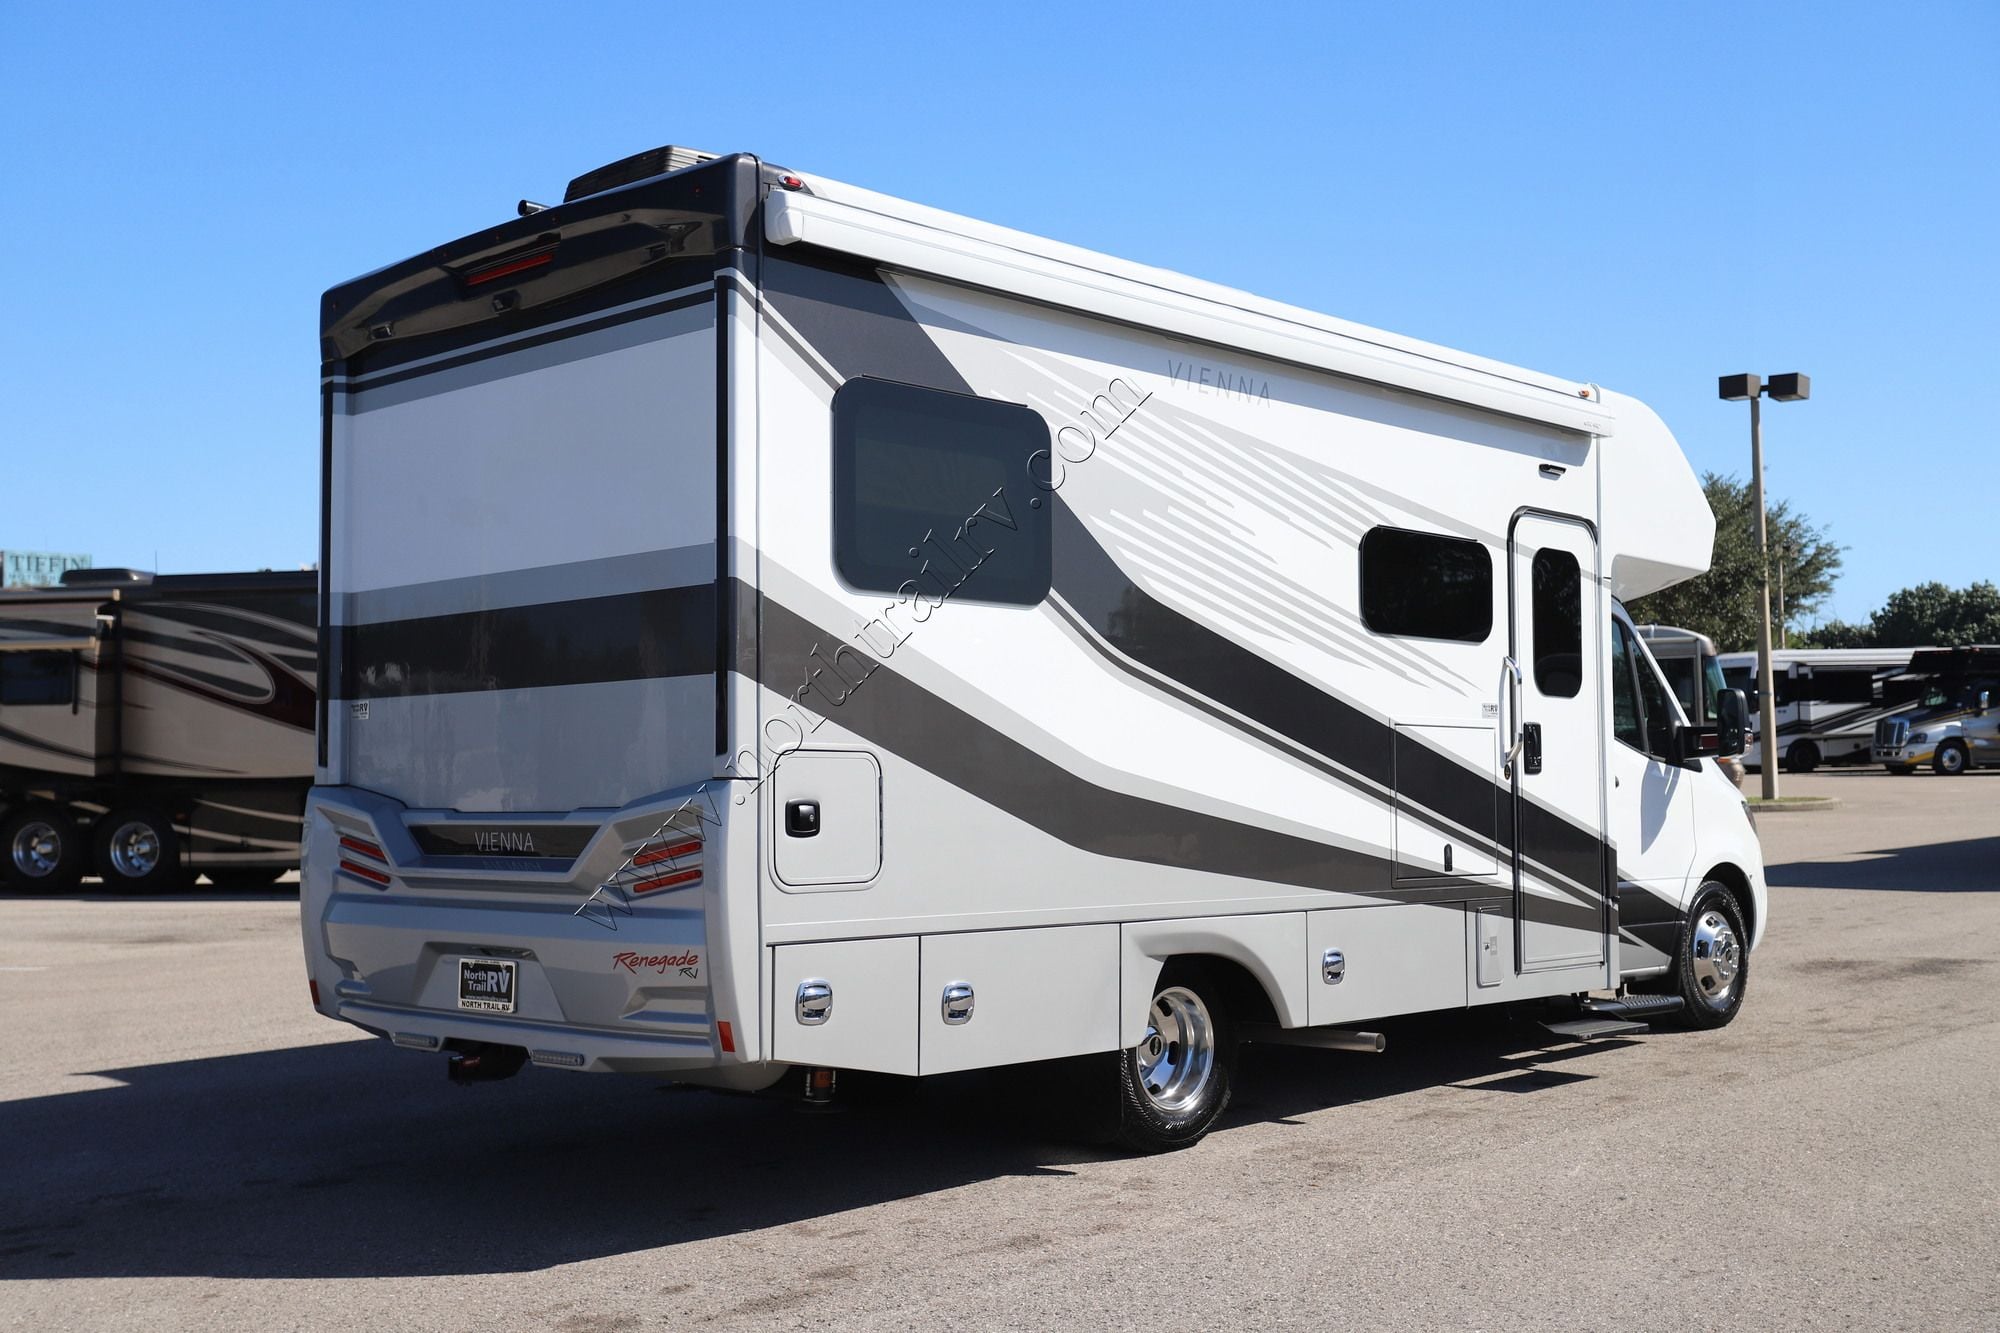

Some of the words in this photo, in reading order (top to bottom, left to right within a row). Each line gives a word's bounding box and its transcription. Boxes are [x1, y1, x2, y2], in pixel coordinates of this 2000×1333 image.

[1167, 359, 1271, 409] VIENNA
[9, 555, 86, 573] TIFFIN
[474, 831, 535, 853] VIENNA
[612, 949, 699, 976] Renegade
[464, 969, 487, 980] North
[487, 970, 510, 993] RV
[678, 967, 699, 980] RV
[468, 981, 487, 992] Trail
[461, 1001, 482, 1009] NORTH
[483, 1002, 500, 1010] TRAIL
[501, 1003, 510, 1011] RV
